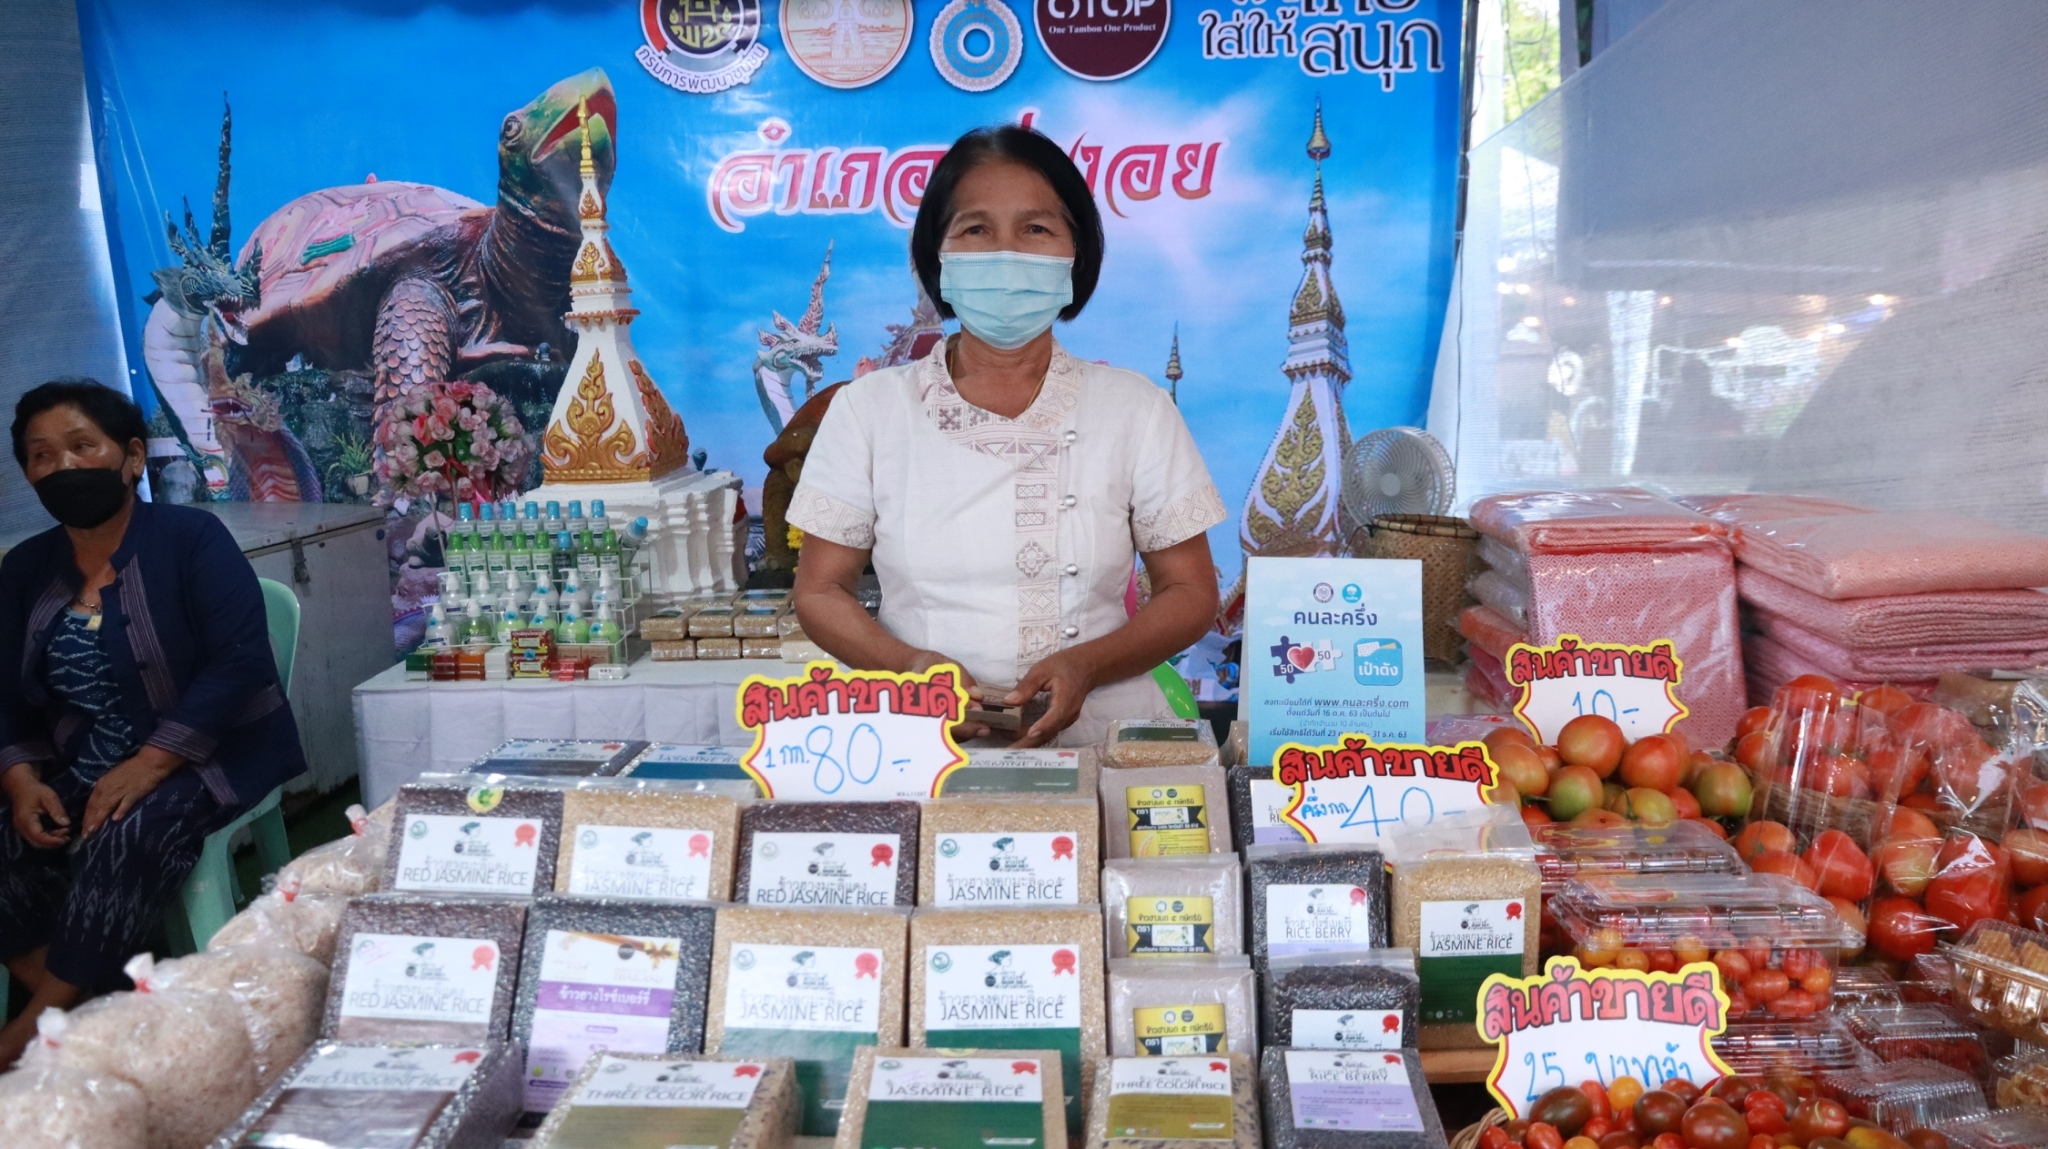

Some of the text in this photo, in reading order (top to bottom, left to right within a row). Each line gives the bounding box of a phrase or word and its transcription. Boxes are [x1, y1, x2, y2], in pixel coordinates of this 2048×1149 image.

[1048, 22, 1157, 35] One Tambon One Product
[1201, 9, 1443, 89] ใส่ให้ สนุก
[638, 46, 767, 90] กรมการพัฒนาชุมชน
[1293, 603, 1378, 626] คนละครึ่ง
[1317, 650, 1331, 661] 50
[1511, 639, 1679, 684] สินค้าขายดี
[1280, 664, 1295, 675] 50
[1358, 660, 1399, 676] เป๋าตัง
[741, 666, 960, 728] สินค้าขายดี
[1314, 695, 1410, 709] www.คนละครึ่ง.com
[1322, 709, 1331, 717] 16
[1349, 710, 1358, 718] 63
[1359, 709, 1391, 718] เป็นต้นไป
[1328, 729, 1336, 737] 23
[1372, 730, 1381, 738] 31
[1397, 730, 1407, 739] 63
[1279, 737, 1494, 787] สินค้าขายดี
[402, 867, 529, 886] RED JASMINE RICE
[583, 879, 695, 898] JASMINE RICE
[756, 888, 889, 906] RED JASMINE RICE
[948, 884, 1063, 901] JASMINE RICE
[1285, 926, 1352, 940] RICE BERRY
[1430, 937, 1513, 952] JASMINE RICE
[348, 991, 486, 1014] RED JASMINE RICE
[1483, 963, 1723, 1041] สินค้าขายดี
[738, 1002, 865, 1022] JASMINE RICE
[940, 1002, 1065, 1021] JASMINE RICE
[1310, 1071, 1389, 1082] RICE BERRY
[886, 1085, 1025, 1098] JASMINE RICE
[1115, 1080, 1151, 1090] THREE
[1201, 1081, 1228, 1091] RICE
[586, 1088, 749, 1101] THREE COLOR RICE
